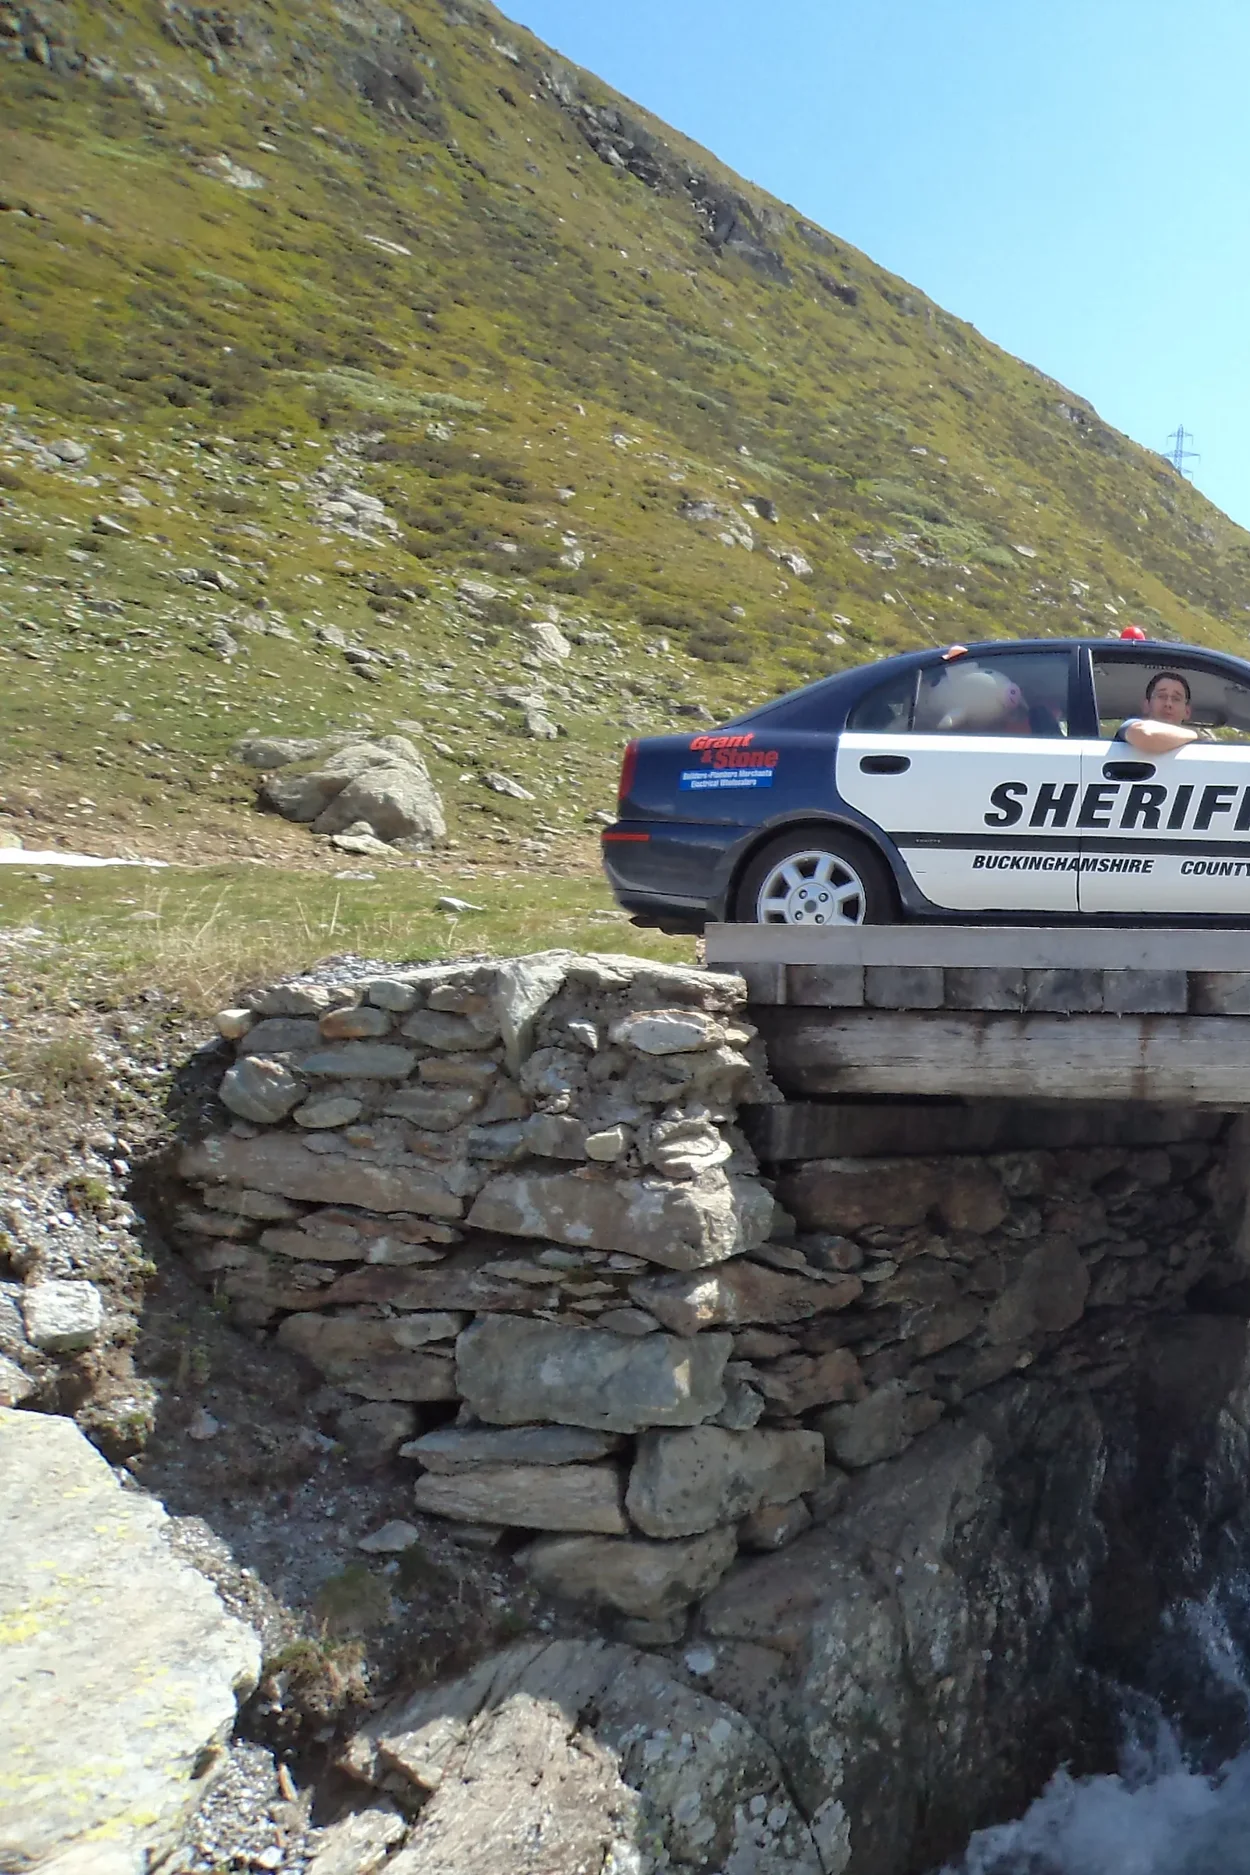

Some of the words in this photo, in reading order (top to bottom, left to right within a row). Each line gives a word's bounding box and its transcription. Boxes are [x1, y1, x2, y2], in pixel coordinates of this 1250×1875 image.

[690, 732, 755, 750] Grant
[714, 749, 779, 769] Stone
[972, 855, 1155, 874] BUCKINGHAMSHIRE
